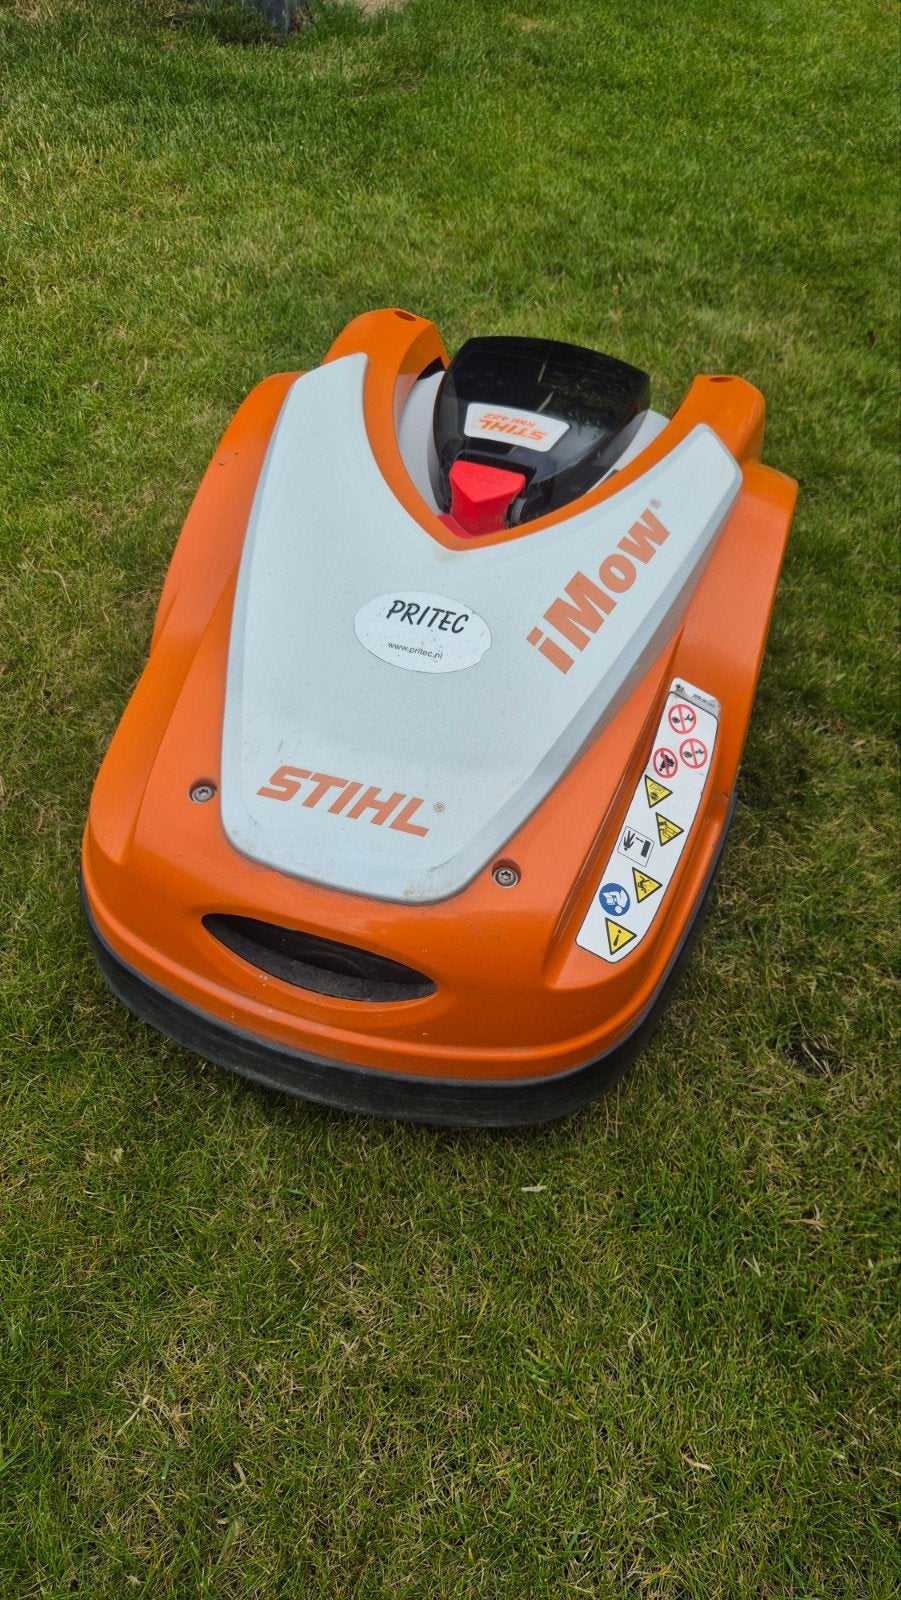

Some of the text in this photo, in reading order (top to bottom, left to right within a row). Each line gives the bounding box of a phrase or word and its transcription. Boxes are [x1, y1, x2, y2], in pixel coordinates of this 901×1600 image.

[479, 419, 548, 441] STIHL
[526, 508, 670, 675] iMow
[386, 600, 469, 633] PRITEC
[388, 642, 443, 660] www.pritec.nl
[256, 765, 430, 838] STIHL
